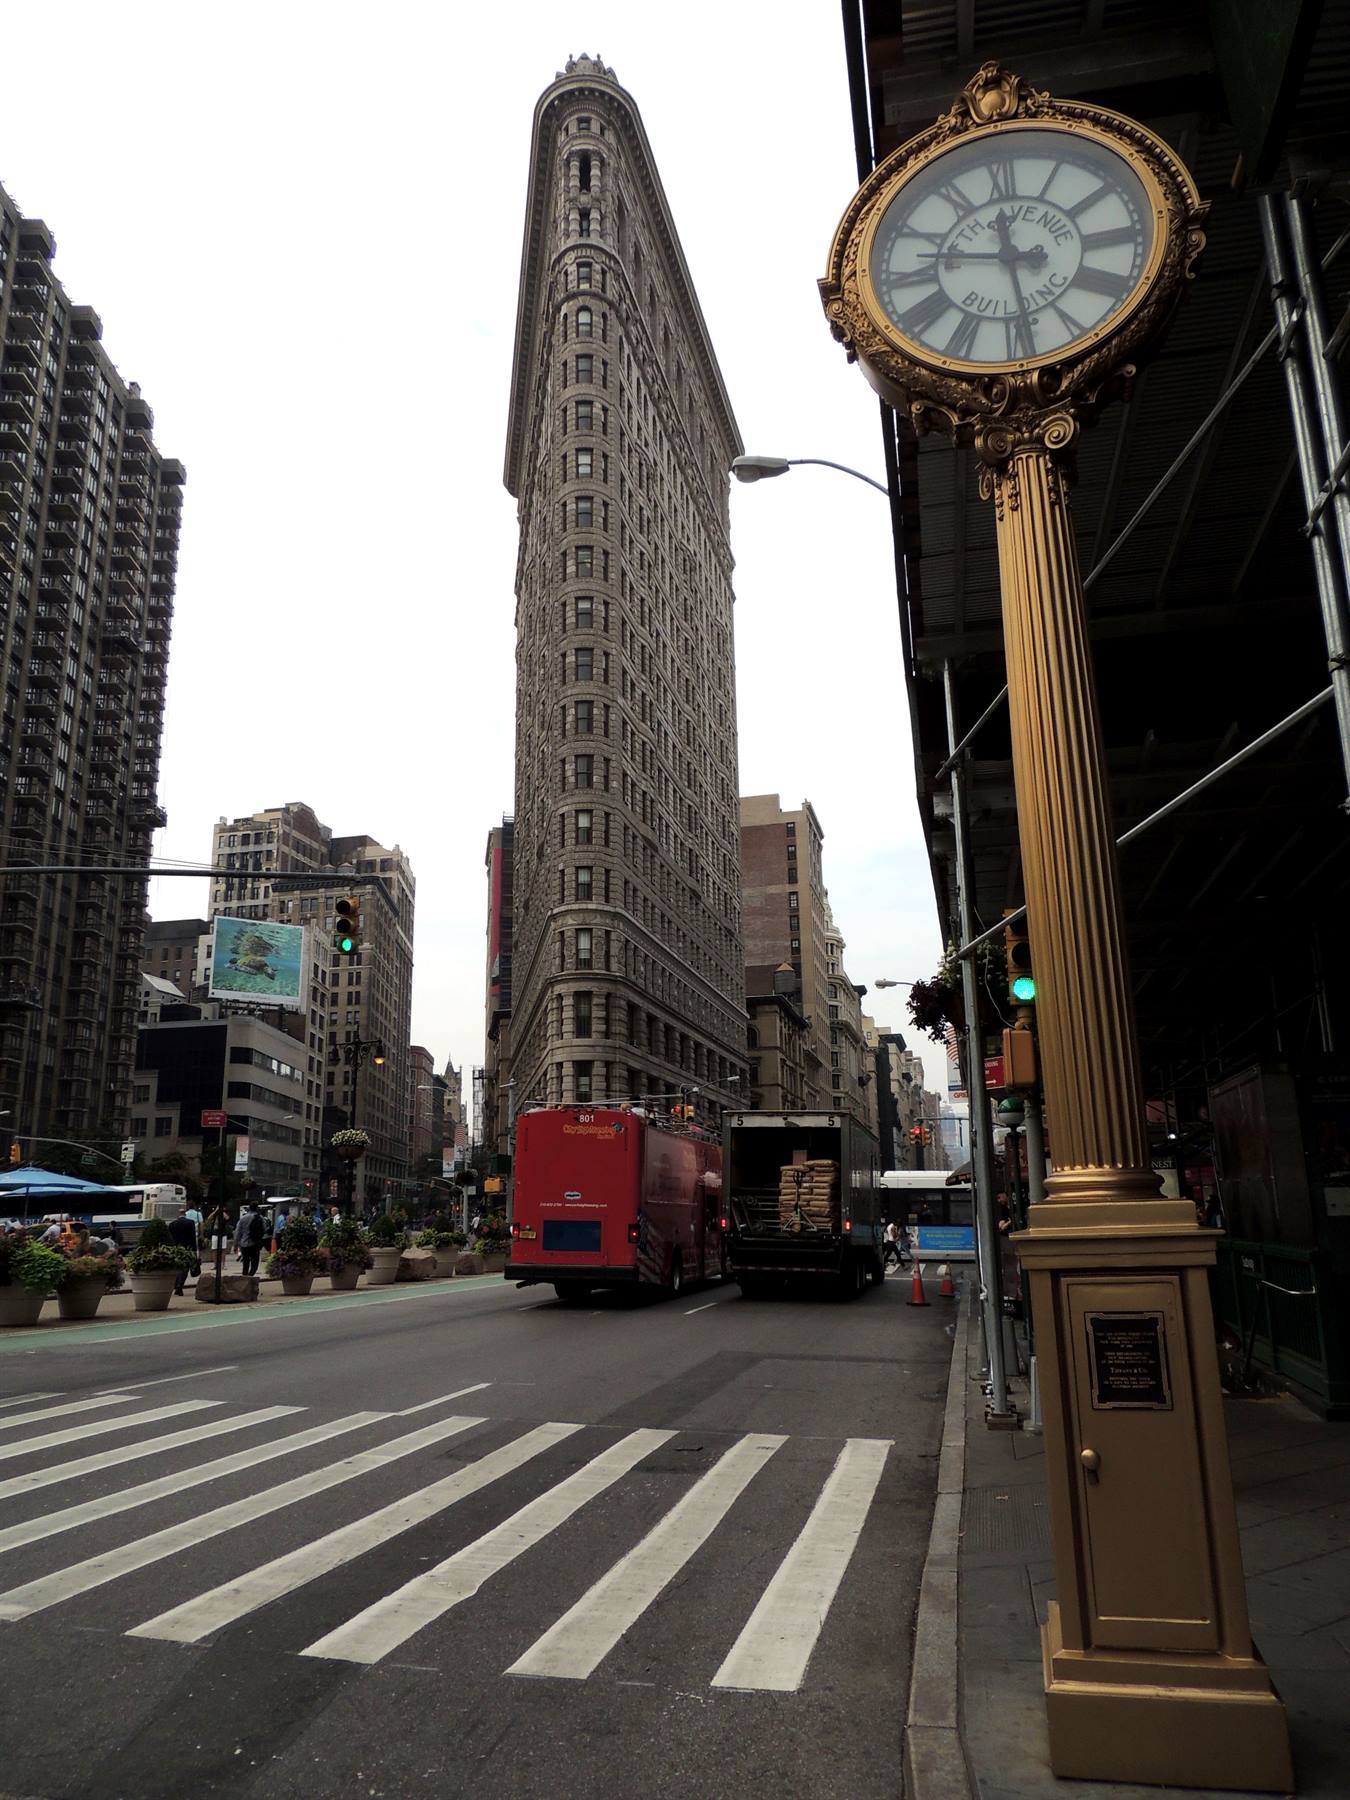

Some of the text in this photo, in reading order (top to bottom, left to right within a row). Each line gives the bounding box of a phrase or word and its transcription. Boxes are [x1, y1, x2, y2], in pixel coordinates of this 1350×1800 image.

[944, 205, 1074, 273] FFTH VENUE
[579, 1114, 595, 1123] 801
[737, 1116, 835, 1127] 5 5
